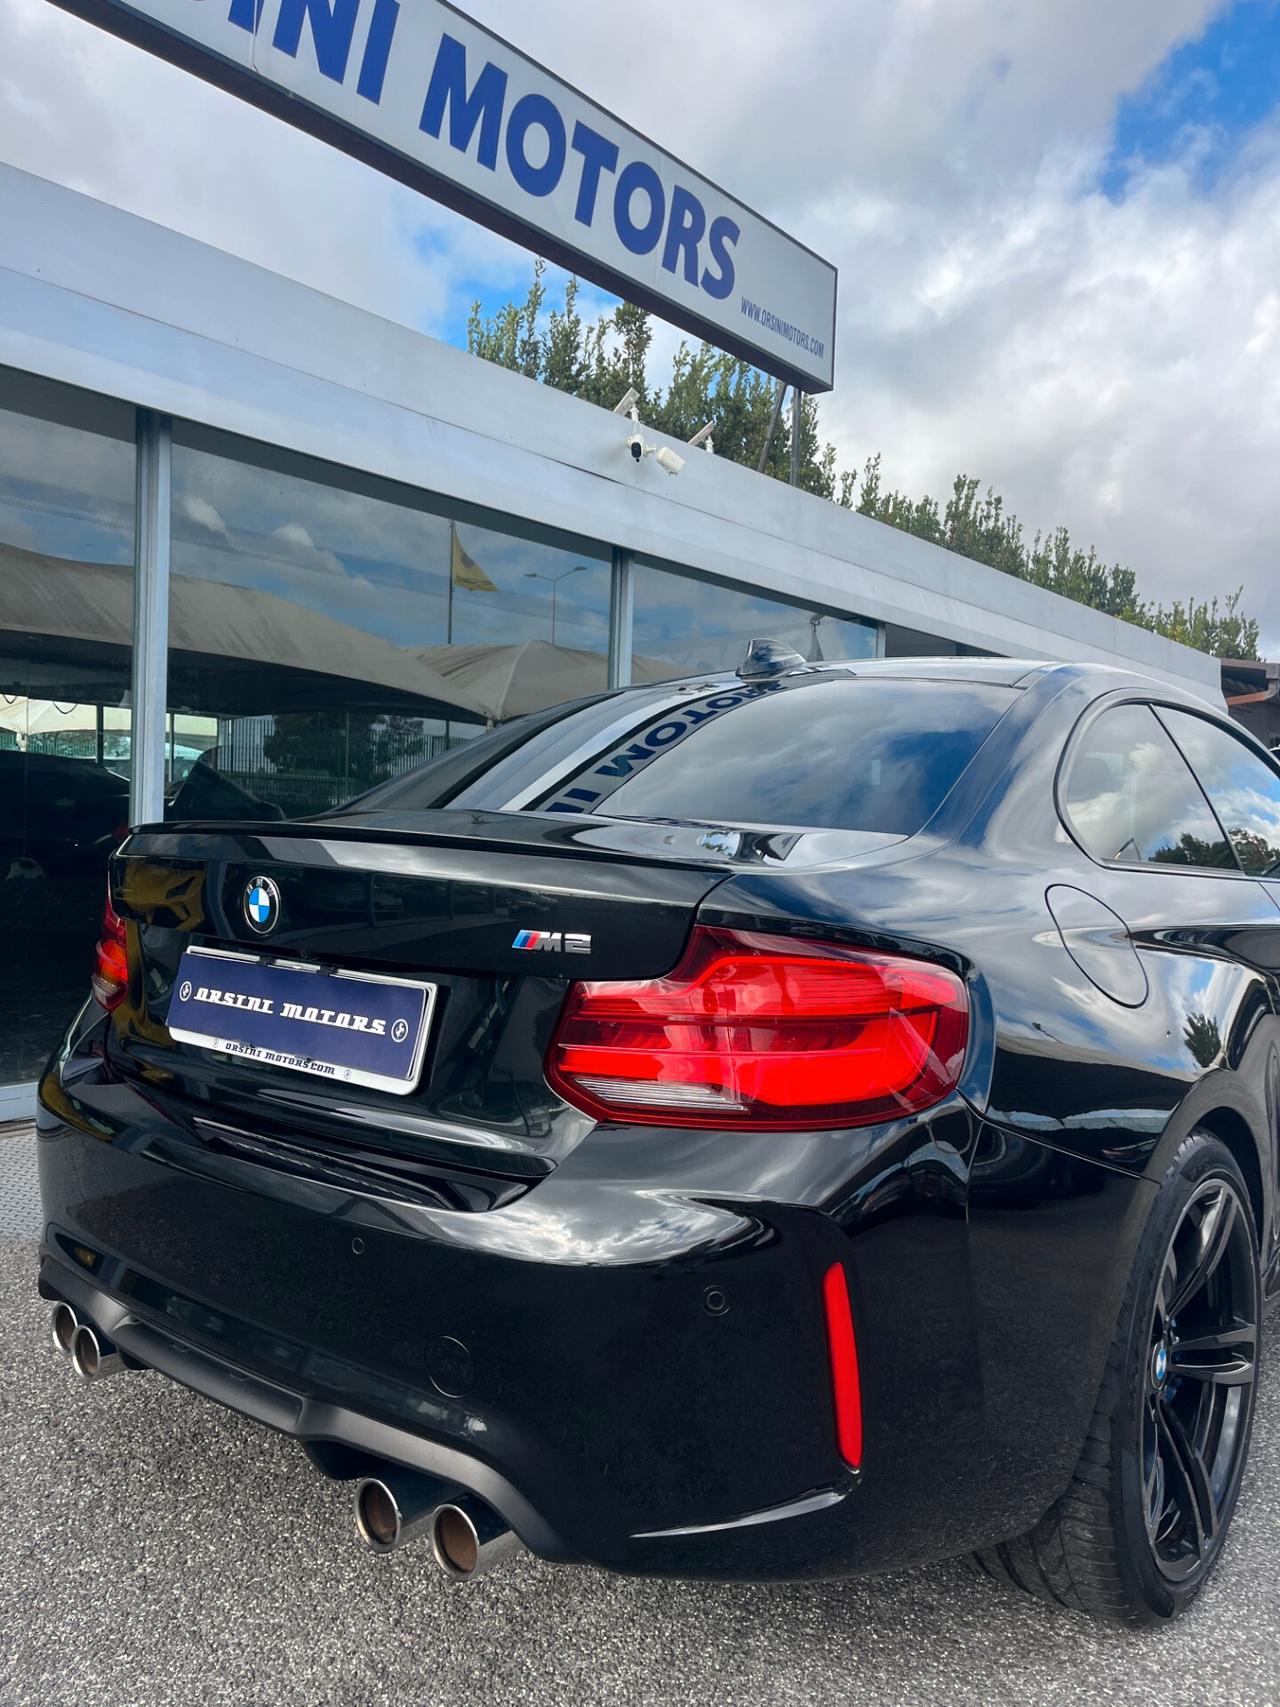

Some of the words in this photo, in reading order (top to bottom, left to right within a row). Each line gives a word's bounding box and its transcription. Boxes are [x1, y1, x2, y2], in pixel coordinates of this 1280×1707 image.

[419, 33, 741, 300] MOTORS
[741, 295, 824, 359] WWW.ORSINIMOTORS.COM
[530, 930, 592, 954] M2
[193, 986, 275, 1014] ORSINI
[279, 1002, 387, 1036] MOTORS
[225, 1042, 262, 1058] ORSINI
